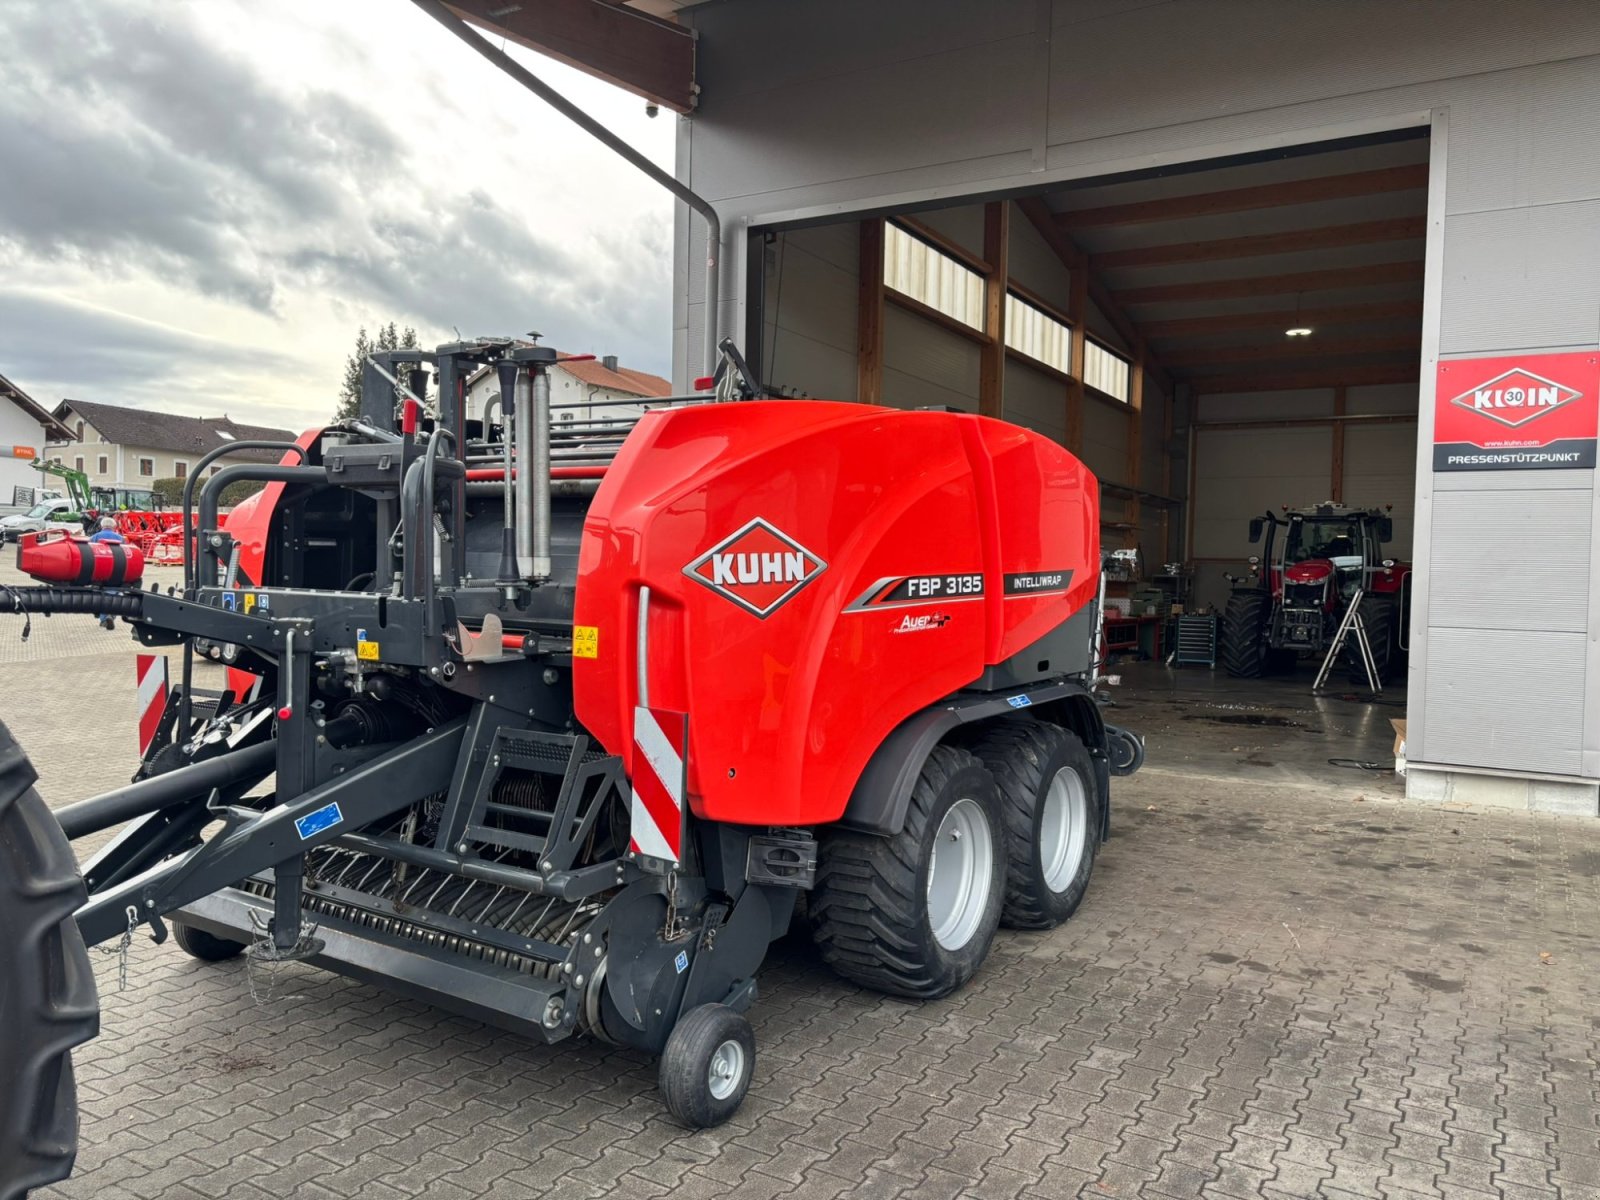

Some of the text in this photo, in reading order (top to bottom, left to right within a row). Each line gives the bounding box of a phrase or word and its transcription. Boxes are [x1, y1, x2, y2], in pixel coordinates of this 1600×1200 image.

[1506, 391, 1523, 402] 30
[1448, 452, 1580, 464] PRESSENSTÜTZPUNKT
[712, 552, 805, 584] KUHN
[908, 576, 982, 597] FBP 3135
[1014, 575, 1062, 589] INTELLIWRAP
